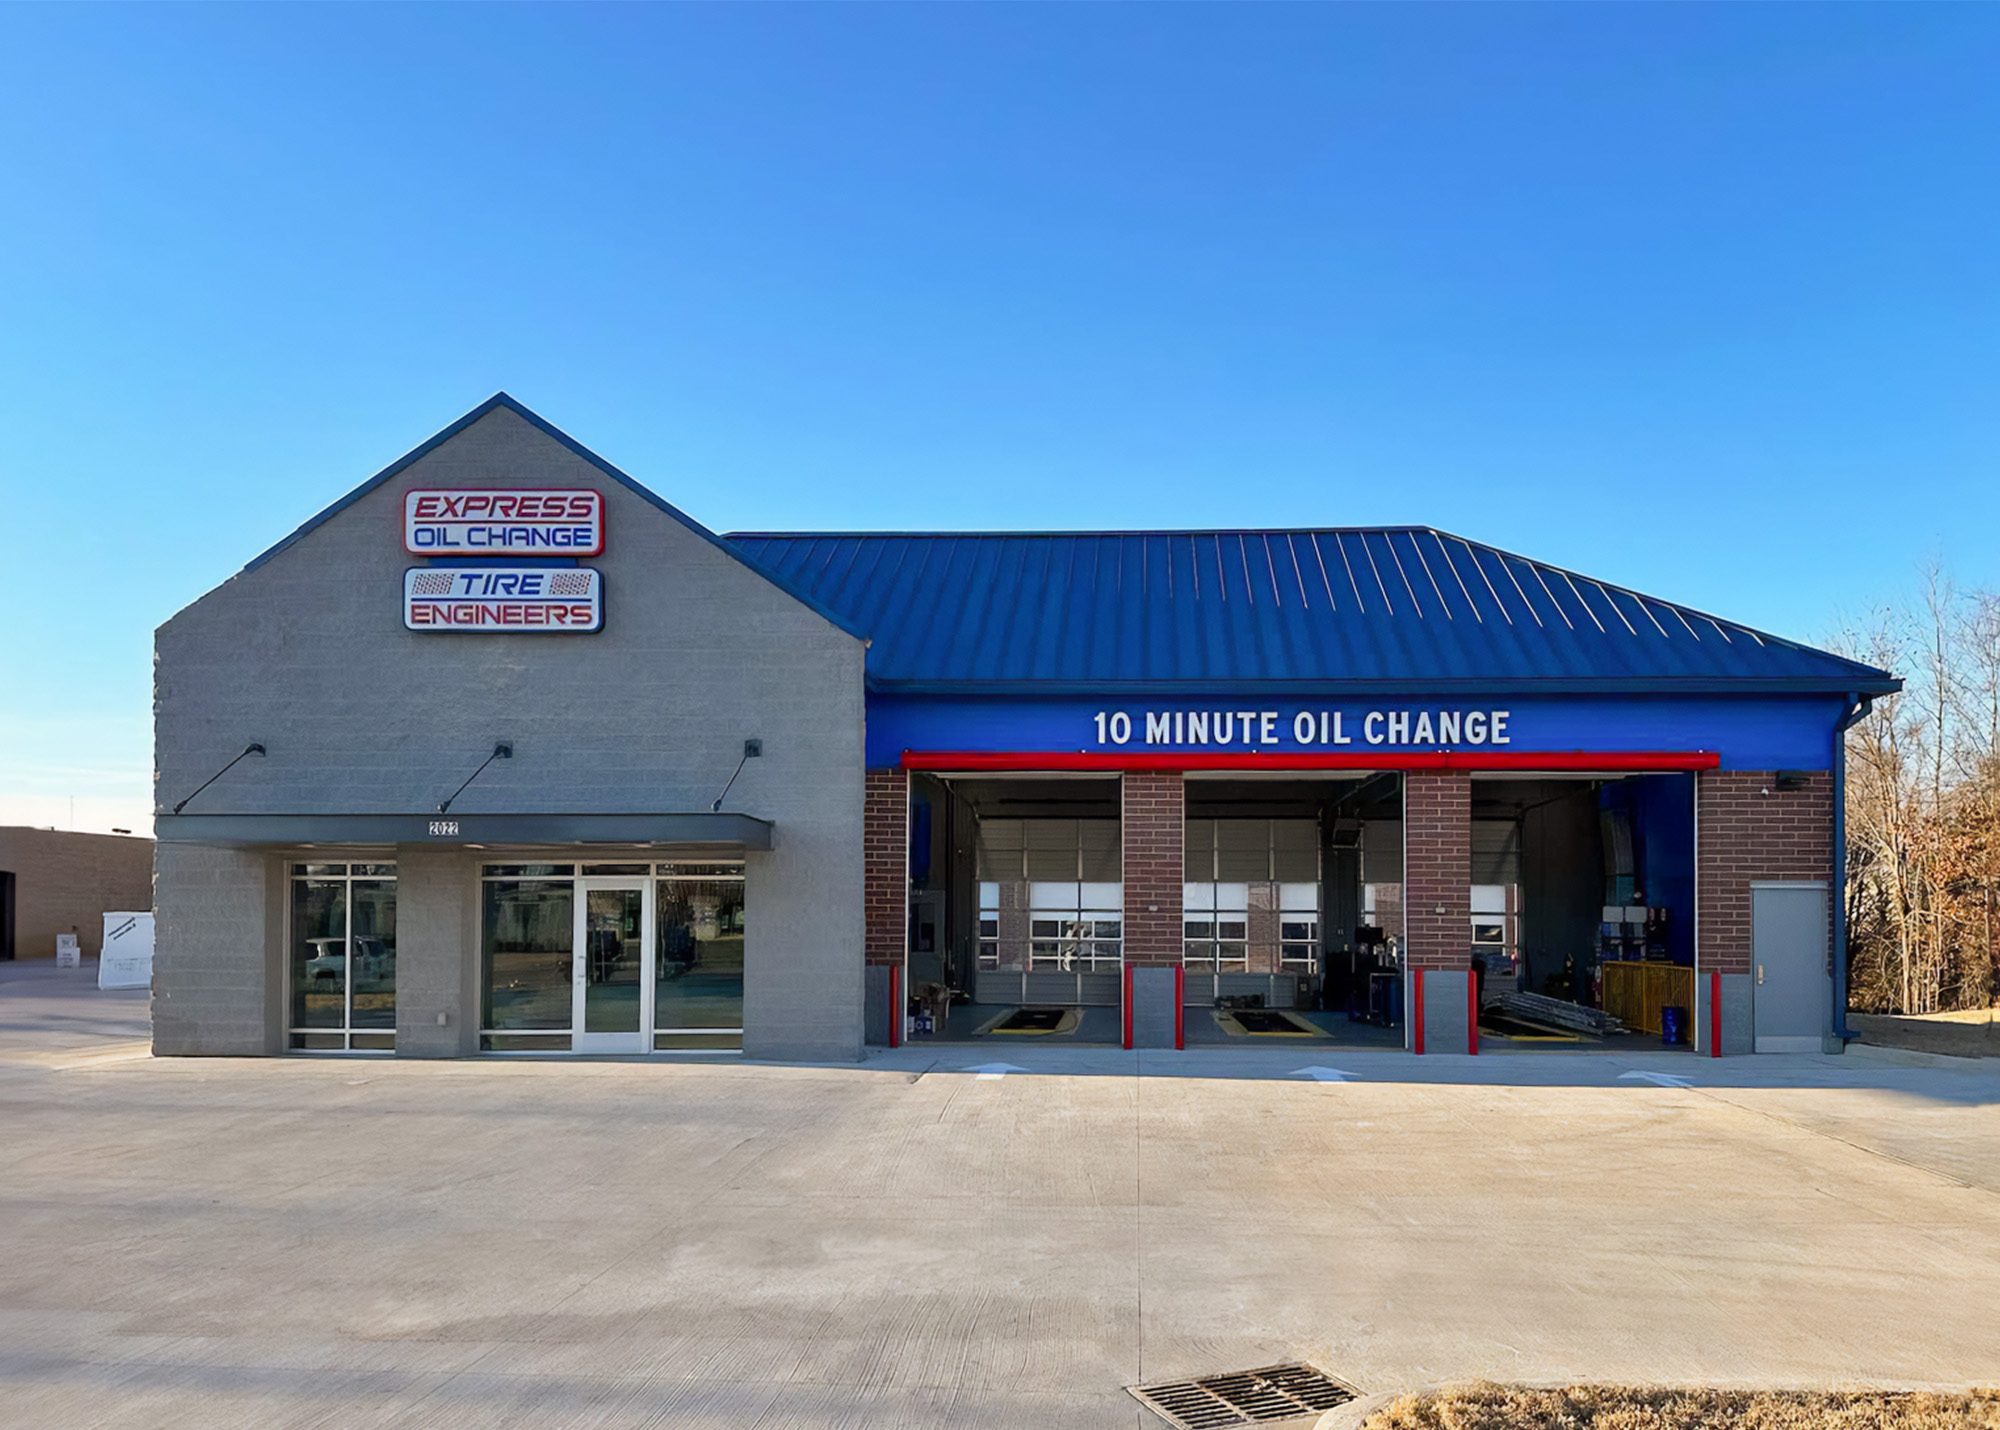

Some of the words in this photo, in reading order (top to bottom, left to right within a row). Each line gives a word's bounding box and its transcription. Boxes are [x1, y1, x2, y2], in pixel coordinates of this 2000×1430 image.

[414, 496, 594, 518] EXPRESS
[414, 527, 460, 546] OIL
[467, 527, 592, 546] CHANGE
[459, 573, 544, 595] TIRE
[411, 604, 593, 624] ENGINEERS
[1094, 711, 1132, 744] 10
[1146, 711, 1279, 744] MINUTE
[1293, 711, 1351, 744] OIL
[1364, 711, 1511, 744] CHANGE
[429, 821, 459, 836] 2022
